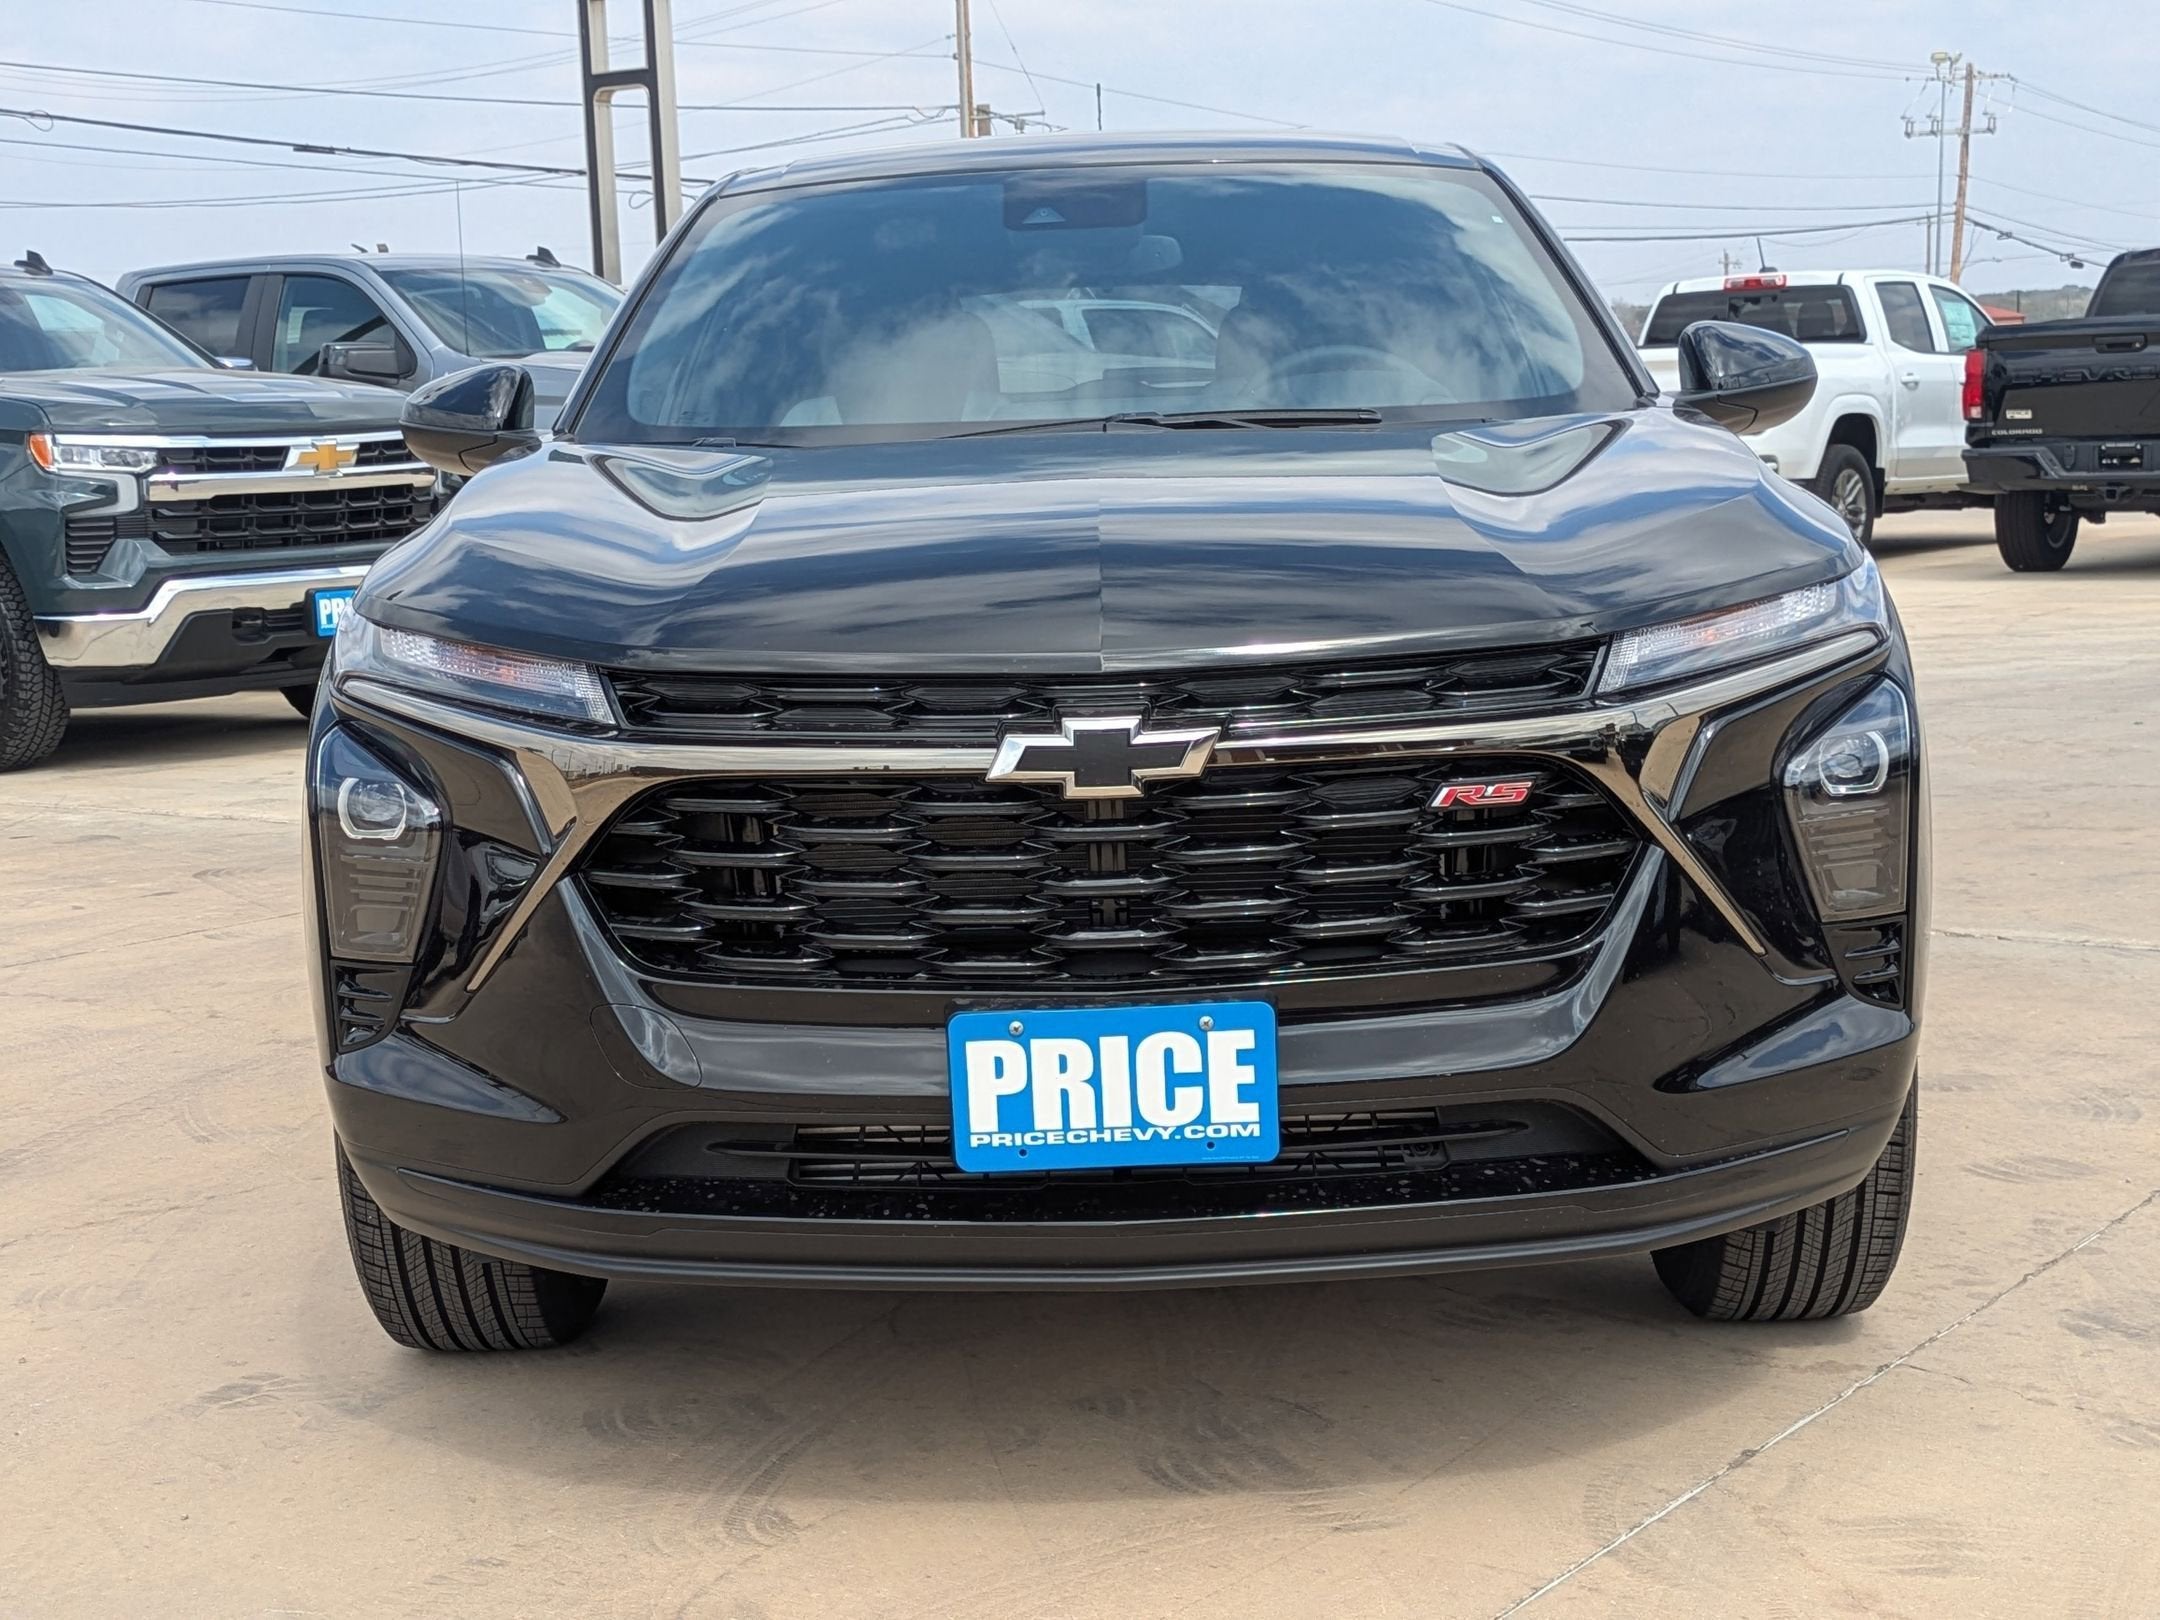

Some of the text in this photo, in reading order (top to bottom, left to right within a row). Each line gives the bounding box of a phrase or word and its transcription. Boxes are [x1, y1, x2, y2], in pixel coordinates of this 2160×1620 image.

[2011, 366, 2160, 384] CHEVRO
[1431, 782, 1532, 807] RS
[965, 1029, 1260, 1133] PRICE
[970, 1123, 1260, 1148] PRICECHEVY.COM
